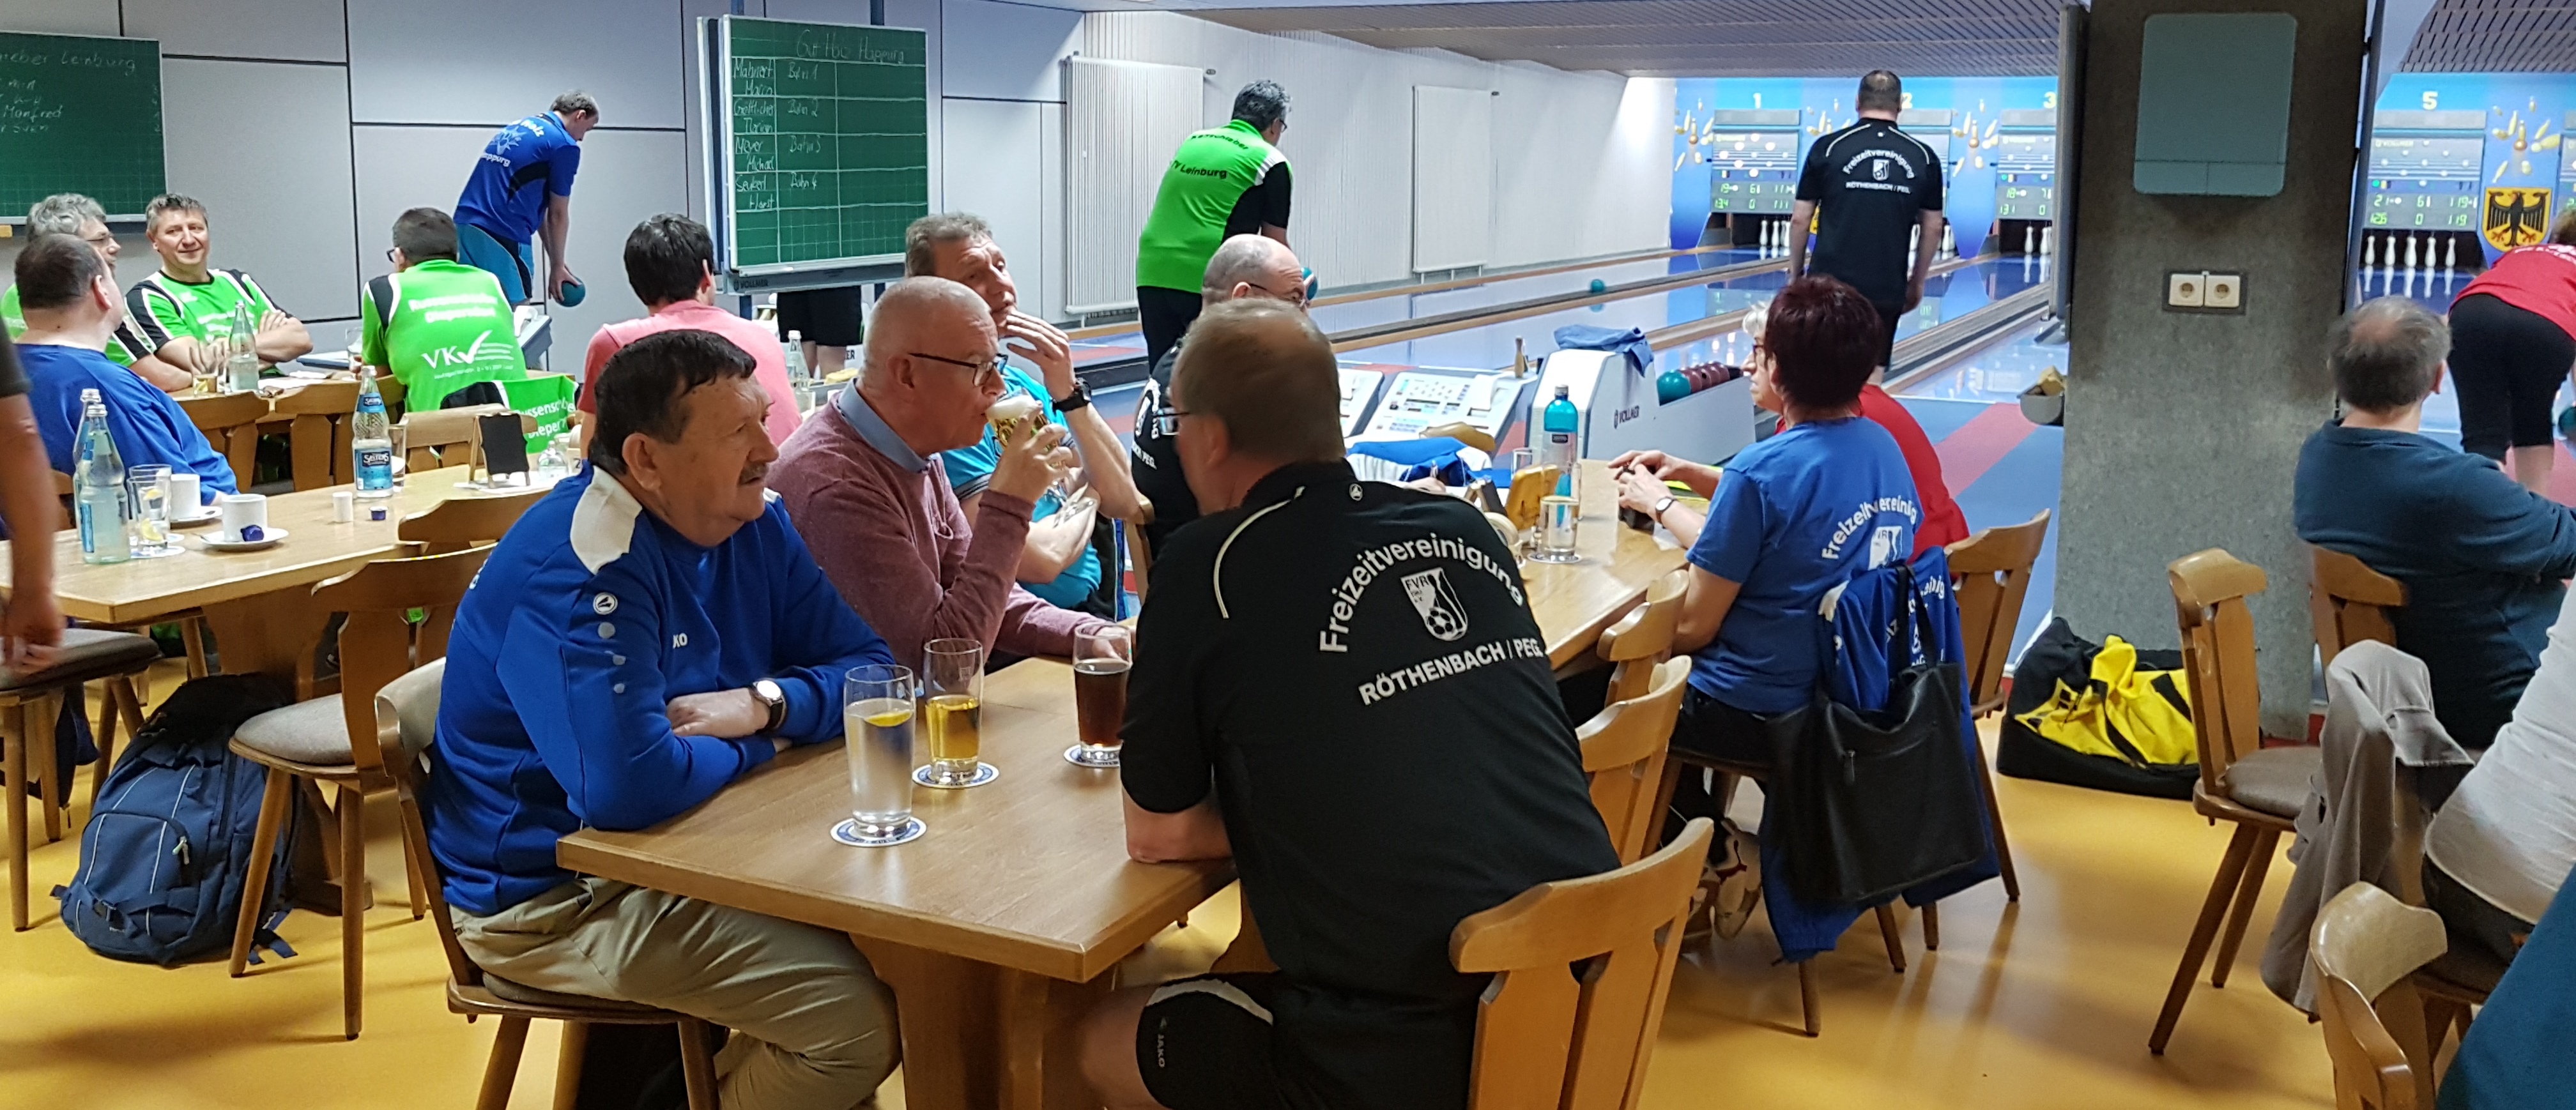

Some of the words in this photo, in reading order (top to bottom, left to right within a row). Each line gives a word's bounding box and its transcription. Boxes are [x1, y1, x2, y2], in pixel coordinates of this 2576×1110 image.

[1753, 93, 1761, 109] 1
[1901, 92, 1913, 109] 2
[2043, 91, 2057, 109] 3
[2423, 91, 2439, 110] 5
[1180, 164, 1227, 179] Leinburg
[1842, 149, 1915, 179] Freizeitvereinigung
[2039, 204, 2046, 216] 0
[2417, 195, 2425, 208] 6
[2415, 213, 2424, 225] 0
[1405, 575, 1429, 591] FVR
[1319, 531, 1524, 653] Freizeitvereinigung
[672, 632, 688, 650] KO
[1358, 641, 1506, 706] RÖTHENBACH
